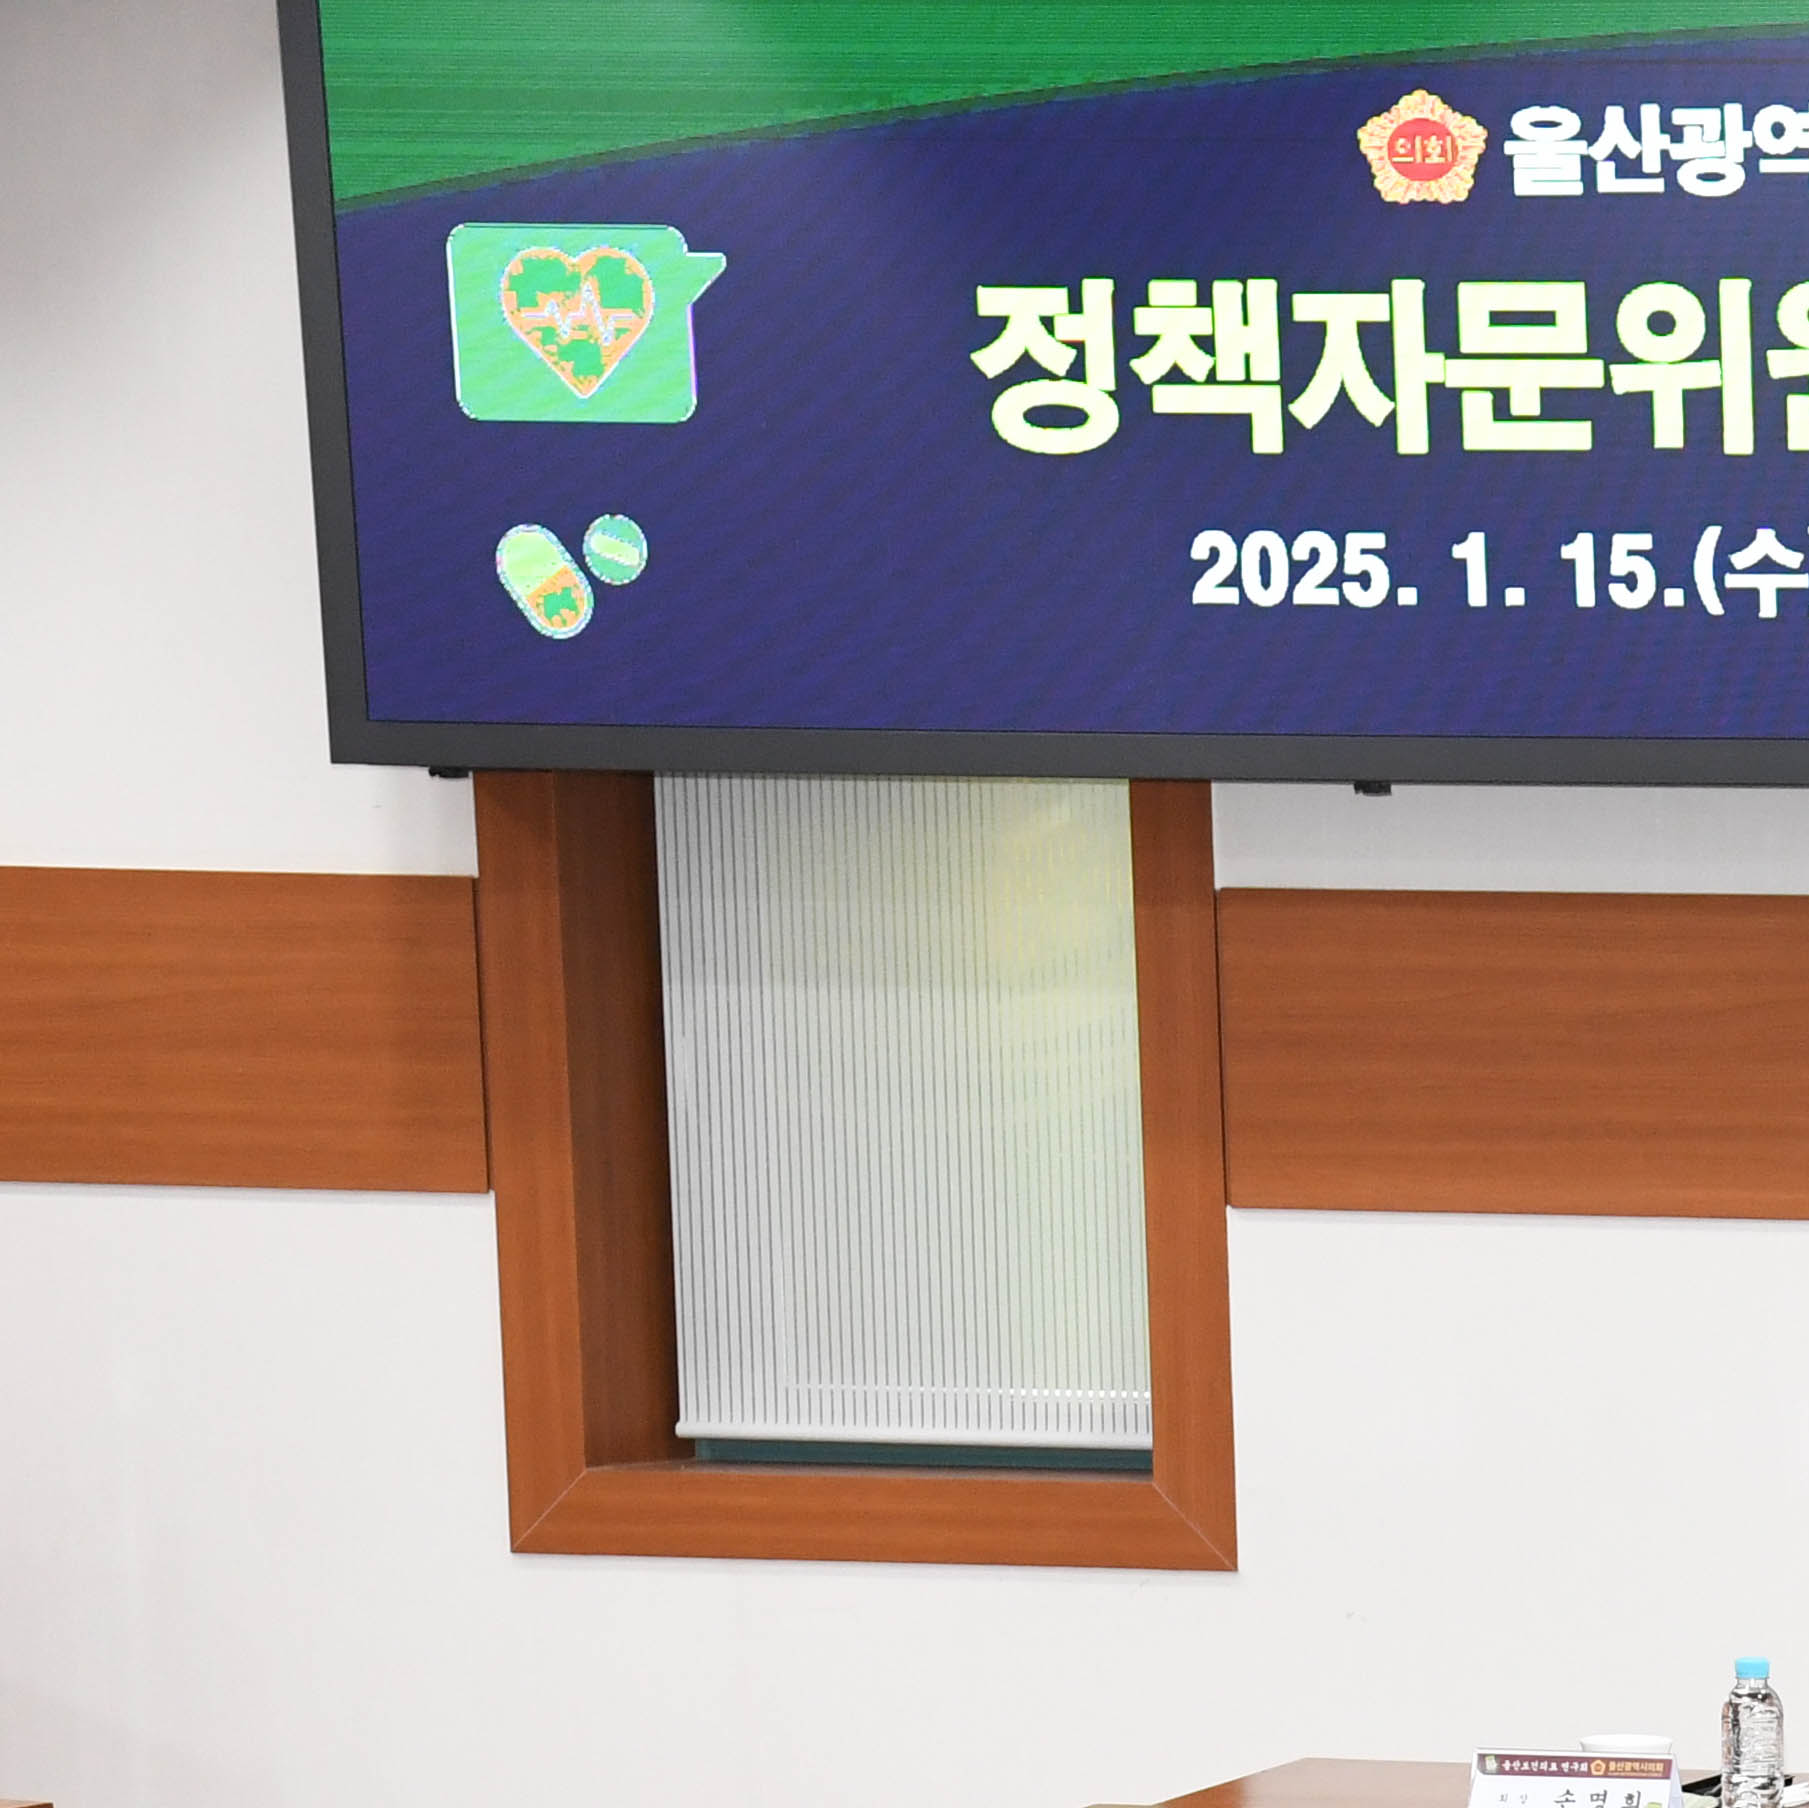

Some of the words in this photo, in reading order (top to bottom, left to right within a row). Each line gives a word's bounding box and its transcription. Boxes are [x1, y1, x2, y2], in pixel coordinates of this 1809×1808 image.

[1391, 135, 1453, 164] 의회
[1190, 529, 1418, 608] 2025.
[1452, 531, 1526, 607] 1.
